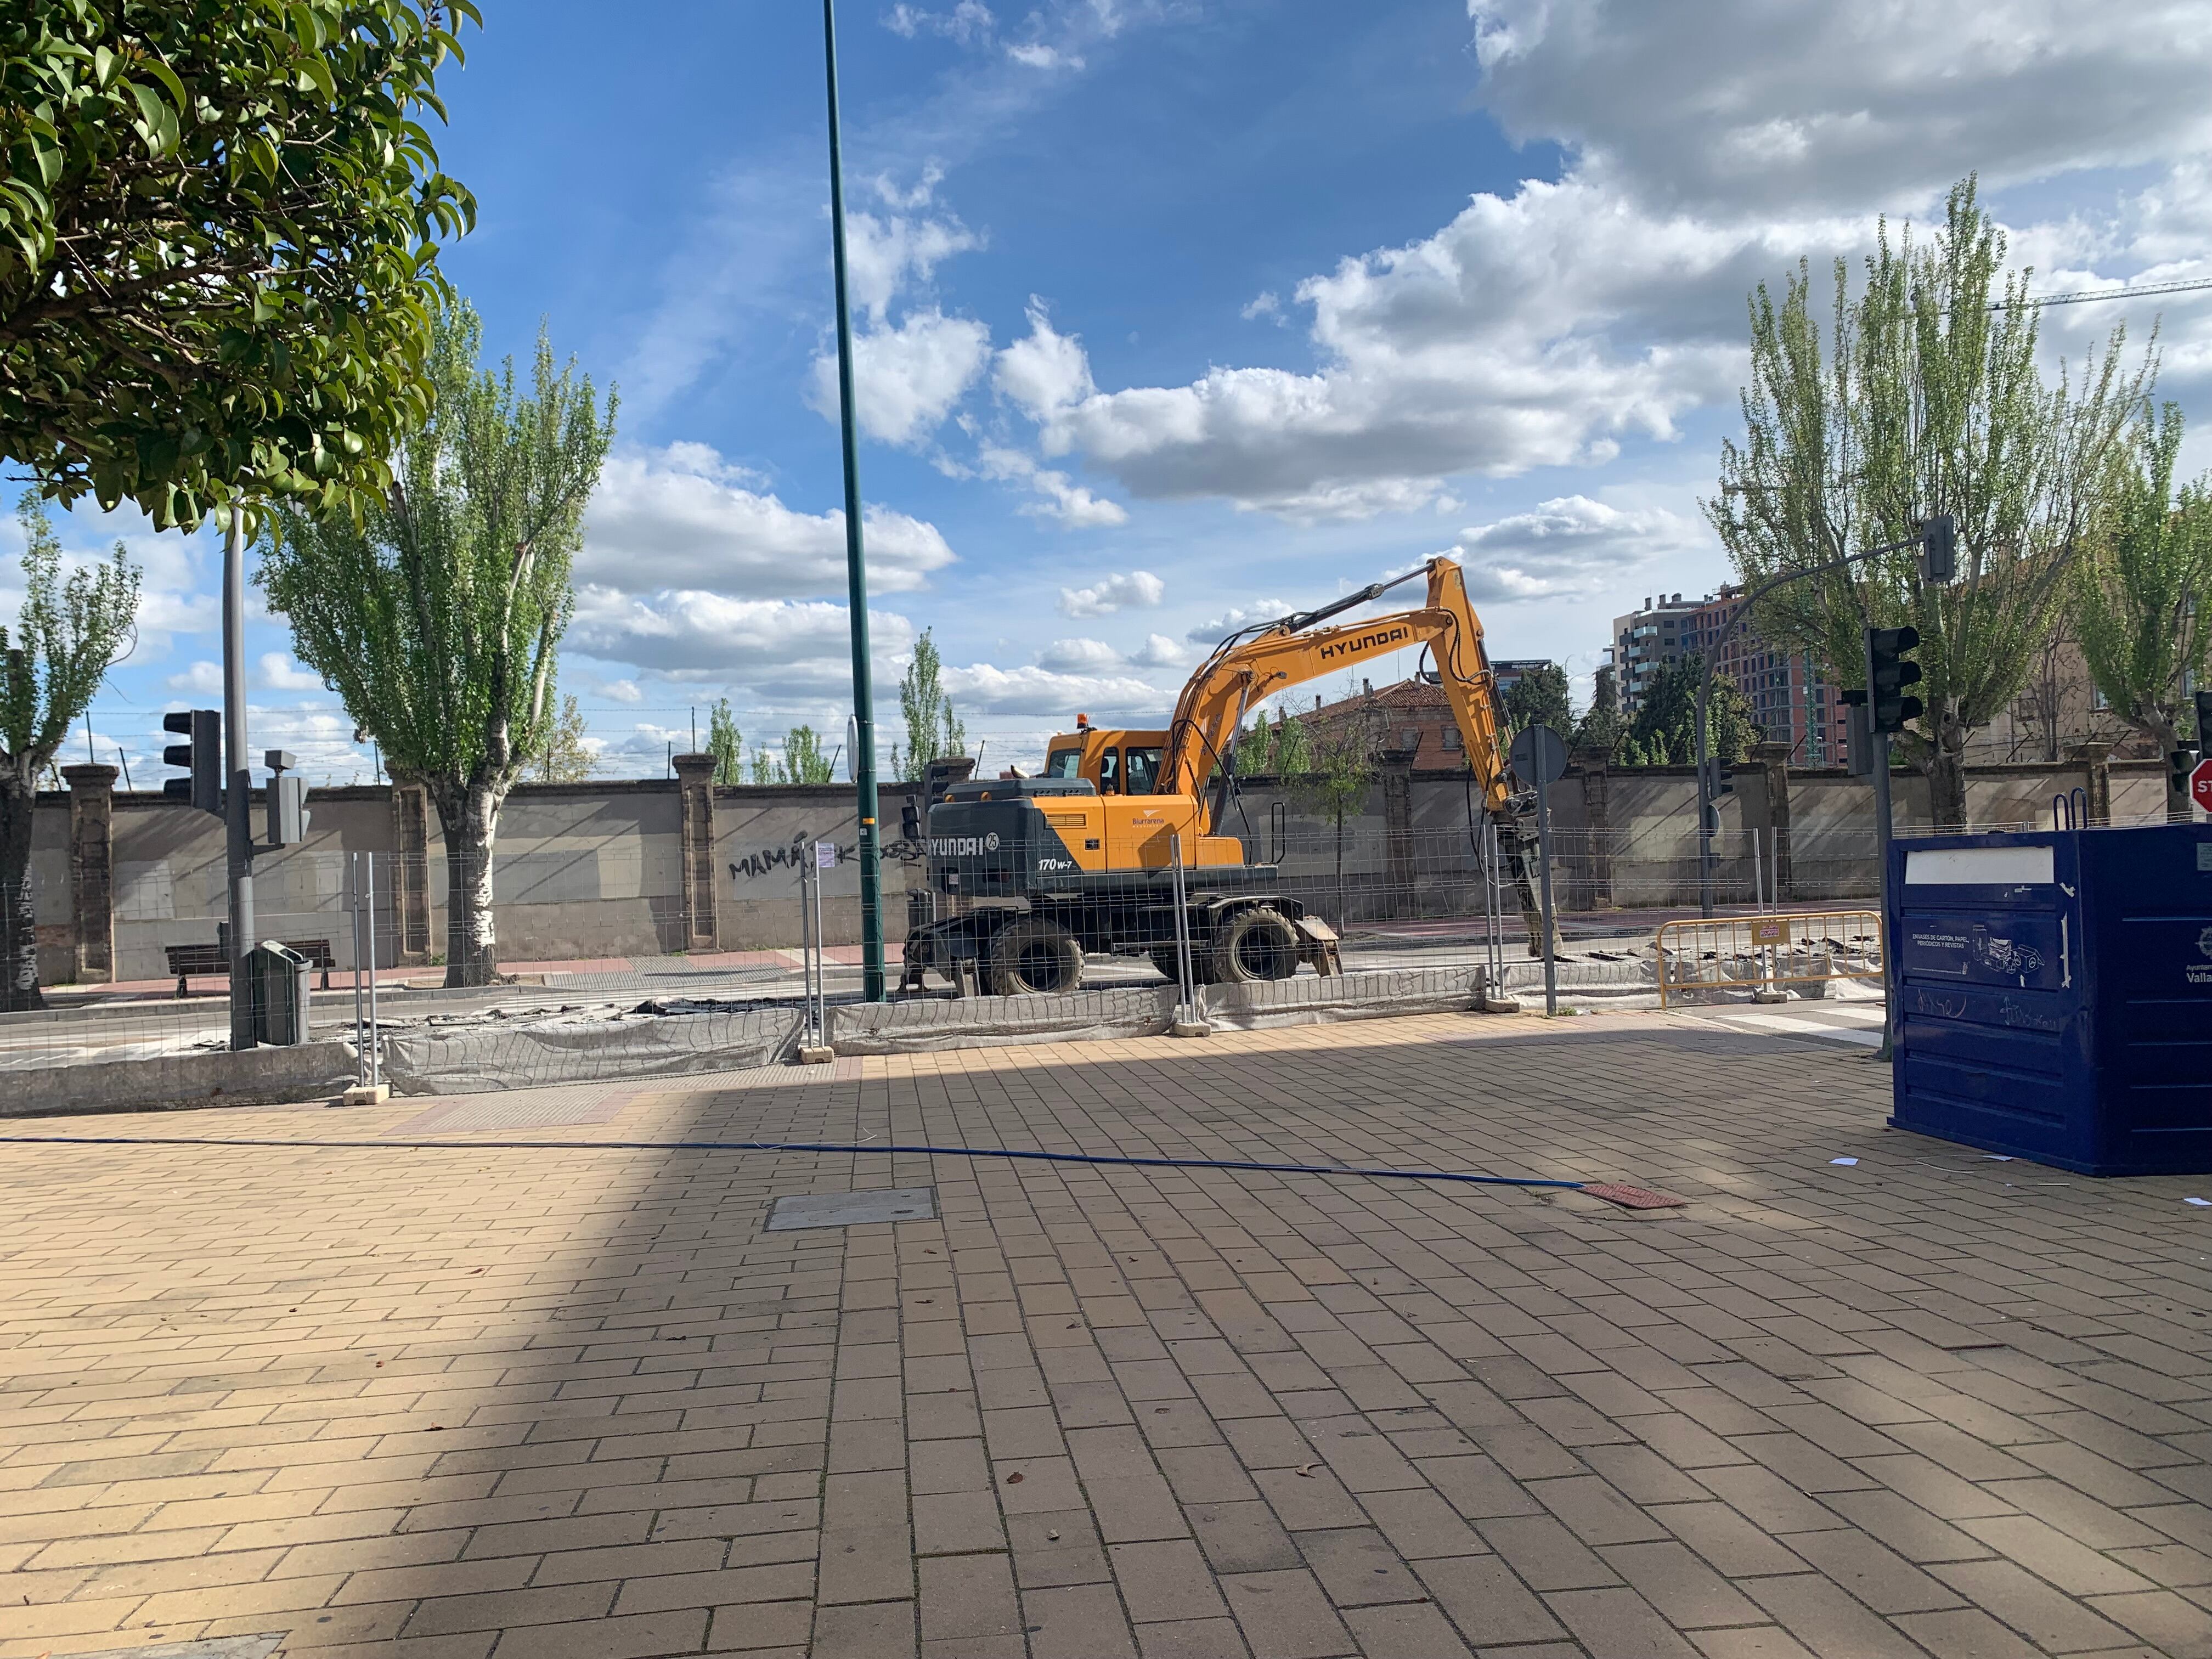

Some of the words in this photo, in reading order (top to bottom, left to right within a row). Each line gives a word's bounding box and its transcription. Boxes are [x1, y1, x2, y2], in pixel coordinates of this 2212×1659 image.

[1321, 627, 1408, 659] HYUNDAI
[988, 834, 997, 848] 25
[1039, 859, 1057, 871] 170
